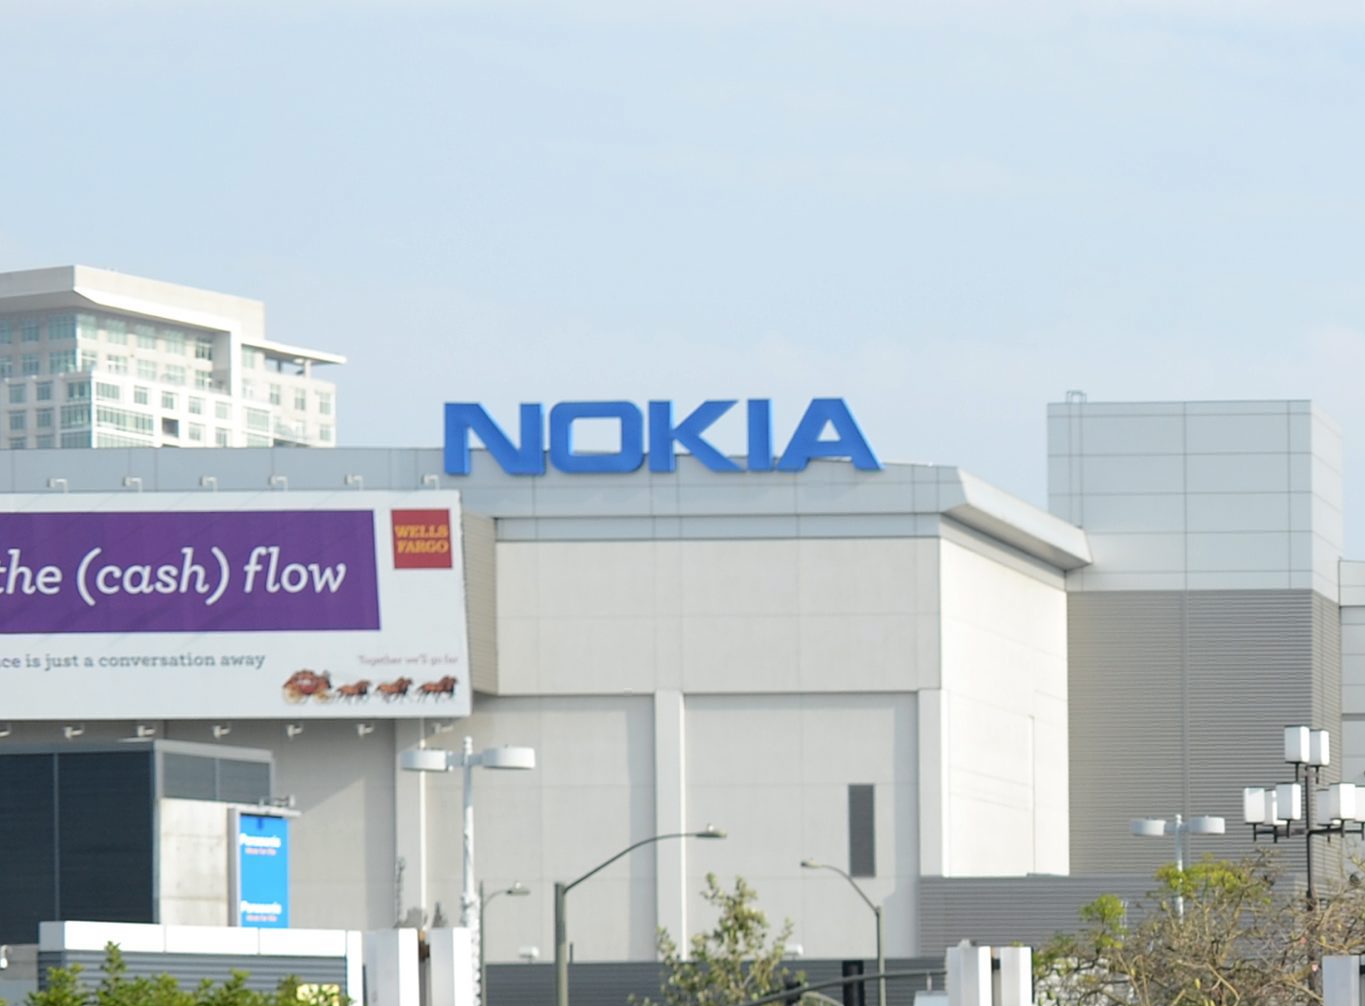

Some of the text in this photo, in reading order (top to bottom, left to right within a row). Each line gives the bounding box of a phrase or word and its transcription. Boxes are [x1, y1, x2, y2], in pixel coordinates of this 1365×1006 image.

[444, 397, 884, 475] NOKIA
[394, 524, 448, 539] WELLS
[397, 540, 449, 554] FARGO
[76, 547, 230, 606] (cash)
[243, 546, 347, 594] flow
[25, 653, 41, 667] is
[44, 653, 79, 671] just
[84, 656, 94, 668] a
[99, 652, 216, 668] conversation
[220, 654, 265, 669] away
